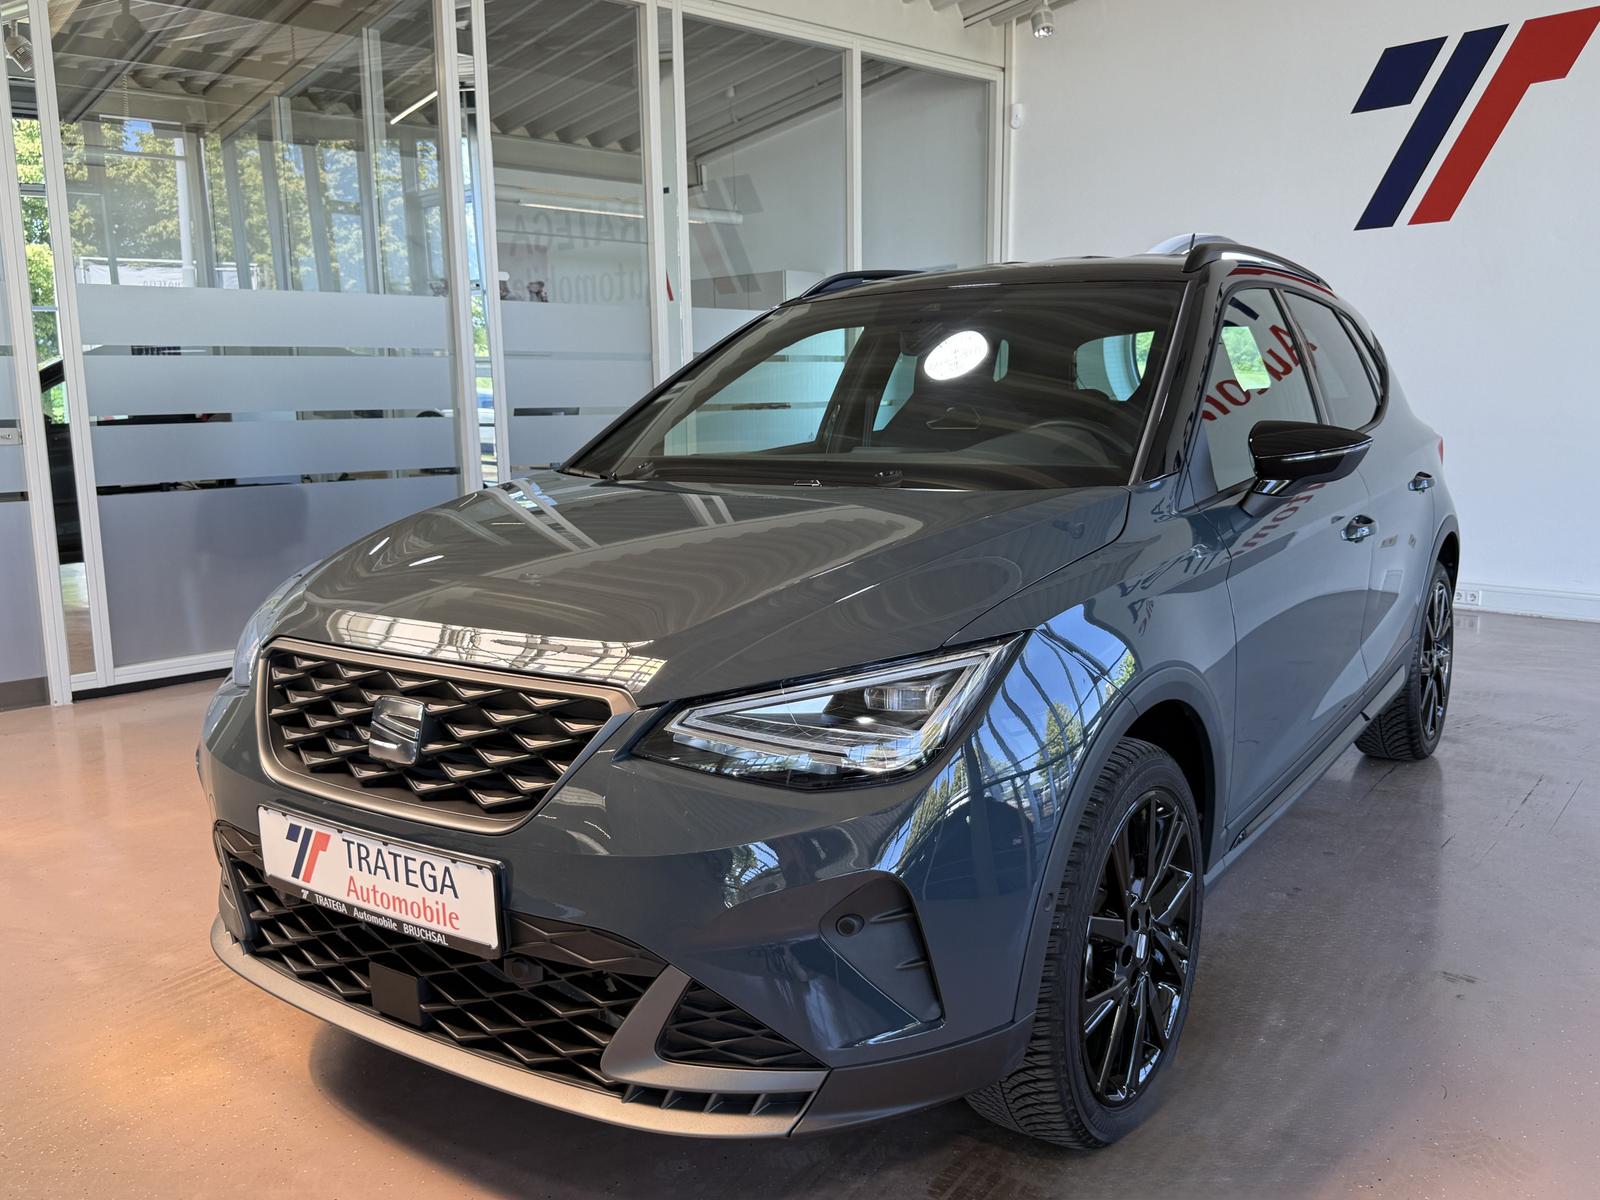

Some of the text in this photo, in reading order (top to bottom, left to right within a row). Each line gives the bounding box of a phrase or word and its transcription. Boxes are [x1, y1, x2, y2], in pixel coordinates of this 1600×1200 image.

[342, 838, 459, 899] TRATEGA
[314, 893, 449, 946] TRATEGA Automobile BRUCHSAL
[347, 876, 460, 930] Automobile
